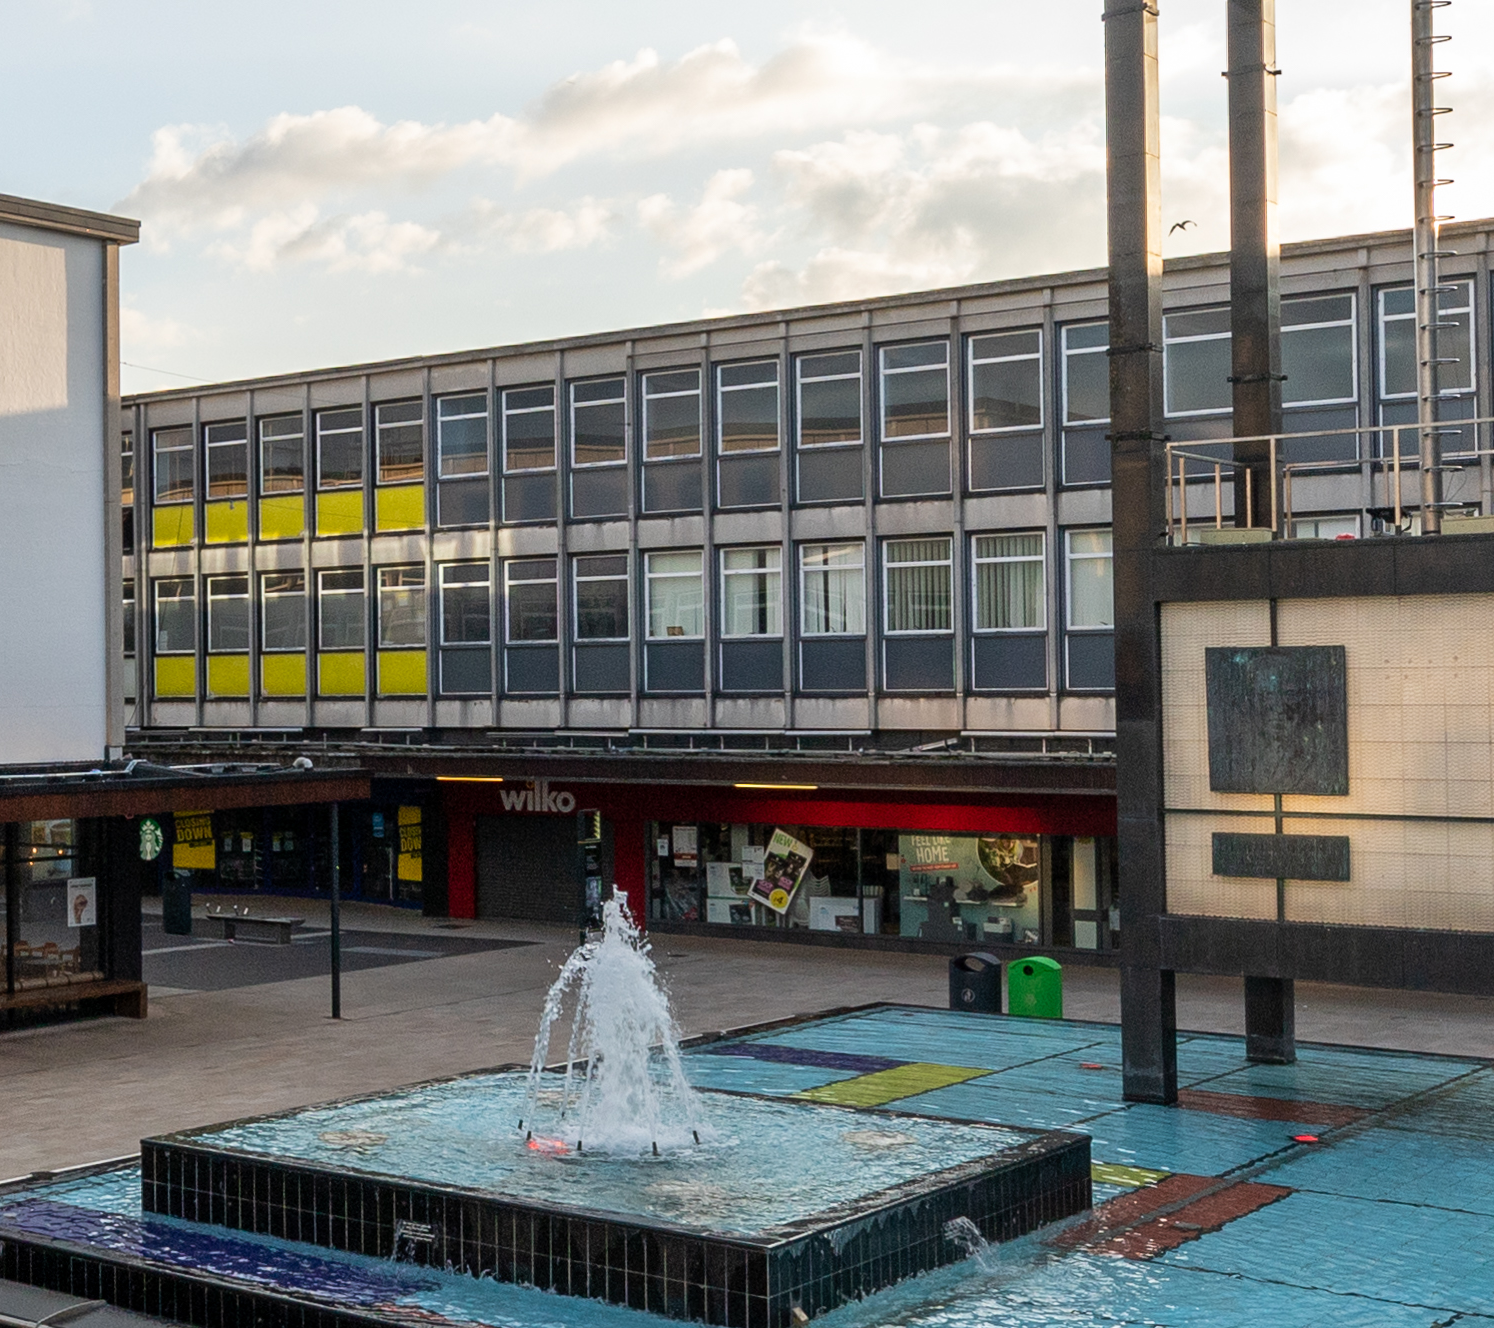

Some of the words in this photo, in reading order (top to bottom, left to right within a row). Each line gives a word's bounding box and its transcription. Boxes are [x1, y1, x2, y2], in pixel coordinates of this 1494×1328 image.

[500, 780, 576, 813] wilko
[176, 826, 213, 842] DOWN
[400, 837, 422, 852] DOW
[916, 845, 949, 863] HOME
